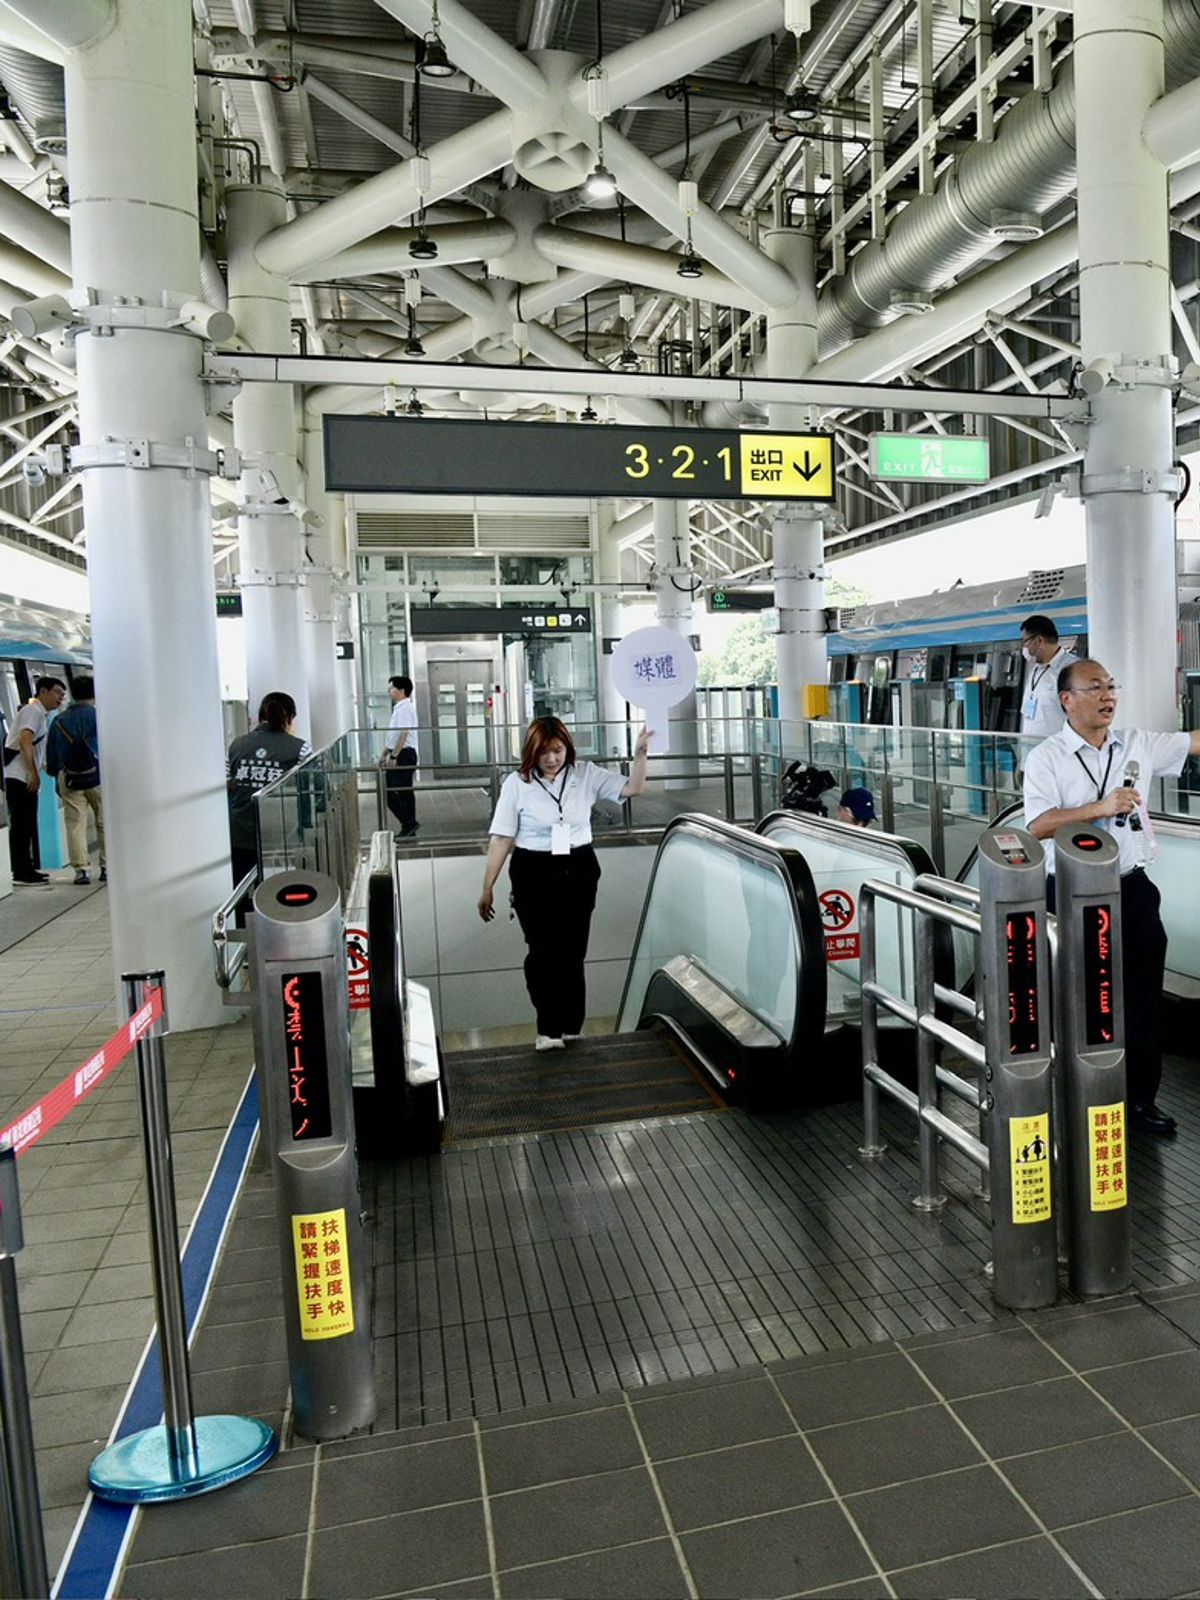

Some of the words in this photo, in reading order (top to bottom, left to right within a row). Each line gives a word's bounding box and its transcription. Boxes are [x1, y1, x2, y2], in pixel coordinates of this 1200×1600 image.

[751, 450, 783, 465] 出口
[751, 469, 783, 482] EXIT
[883, 462, 917, 473] EXIT
[634, 655, 676, 682] 媒體
[1094, 1113, 1110, 1195] 請緊握扶手
[1110, 1111, 1124, 1193] 扶梯速度快
[299, 1222, 323, 1319] 請緊握扶手
[321, 1220, 345, 1316] 扶梯速度快
